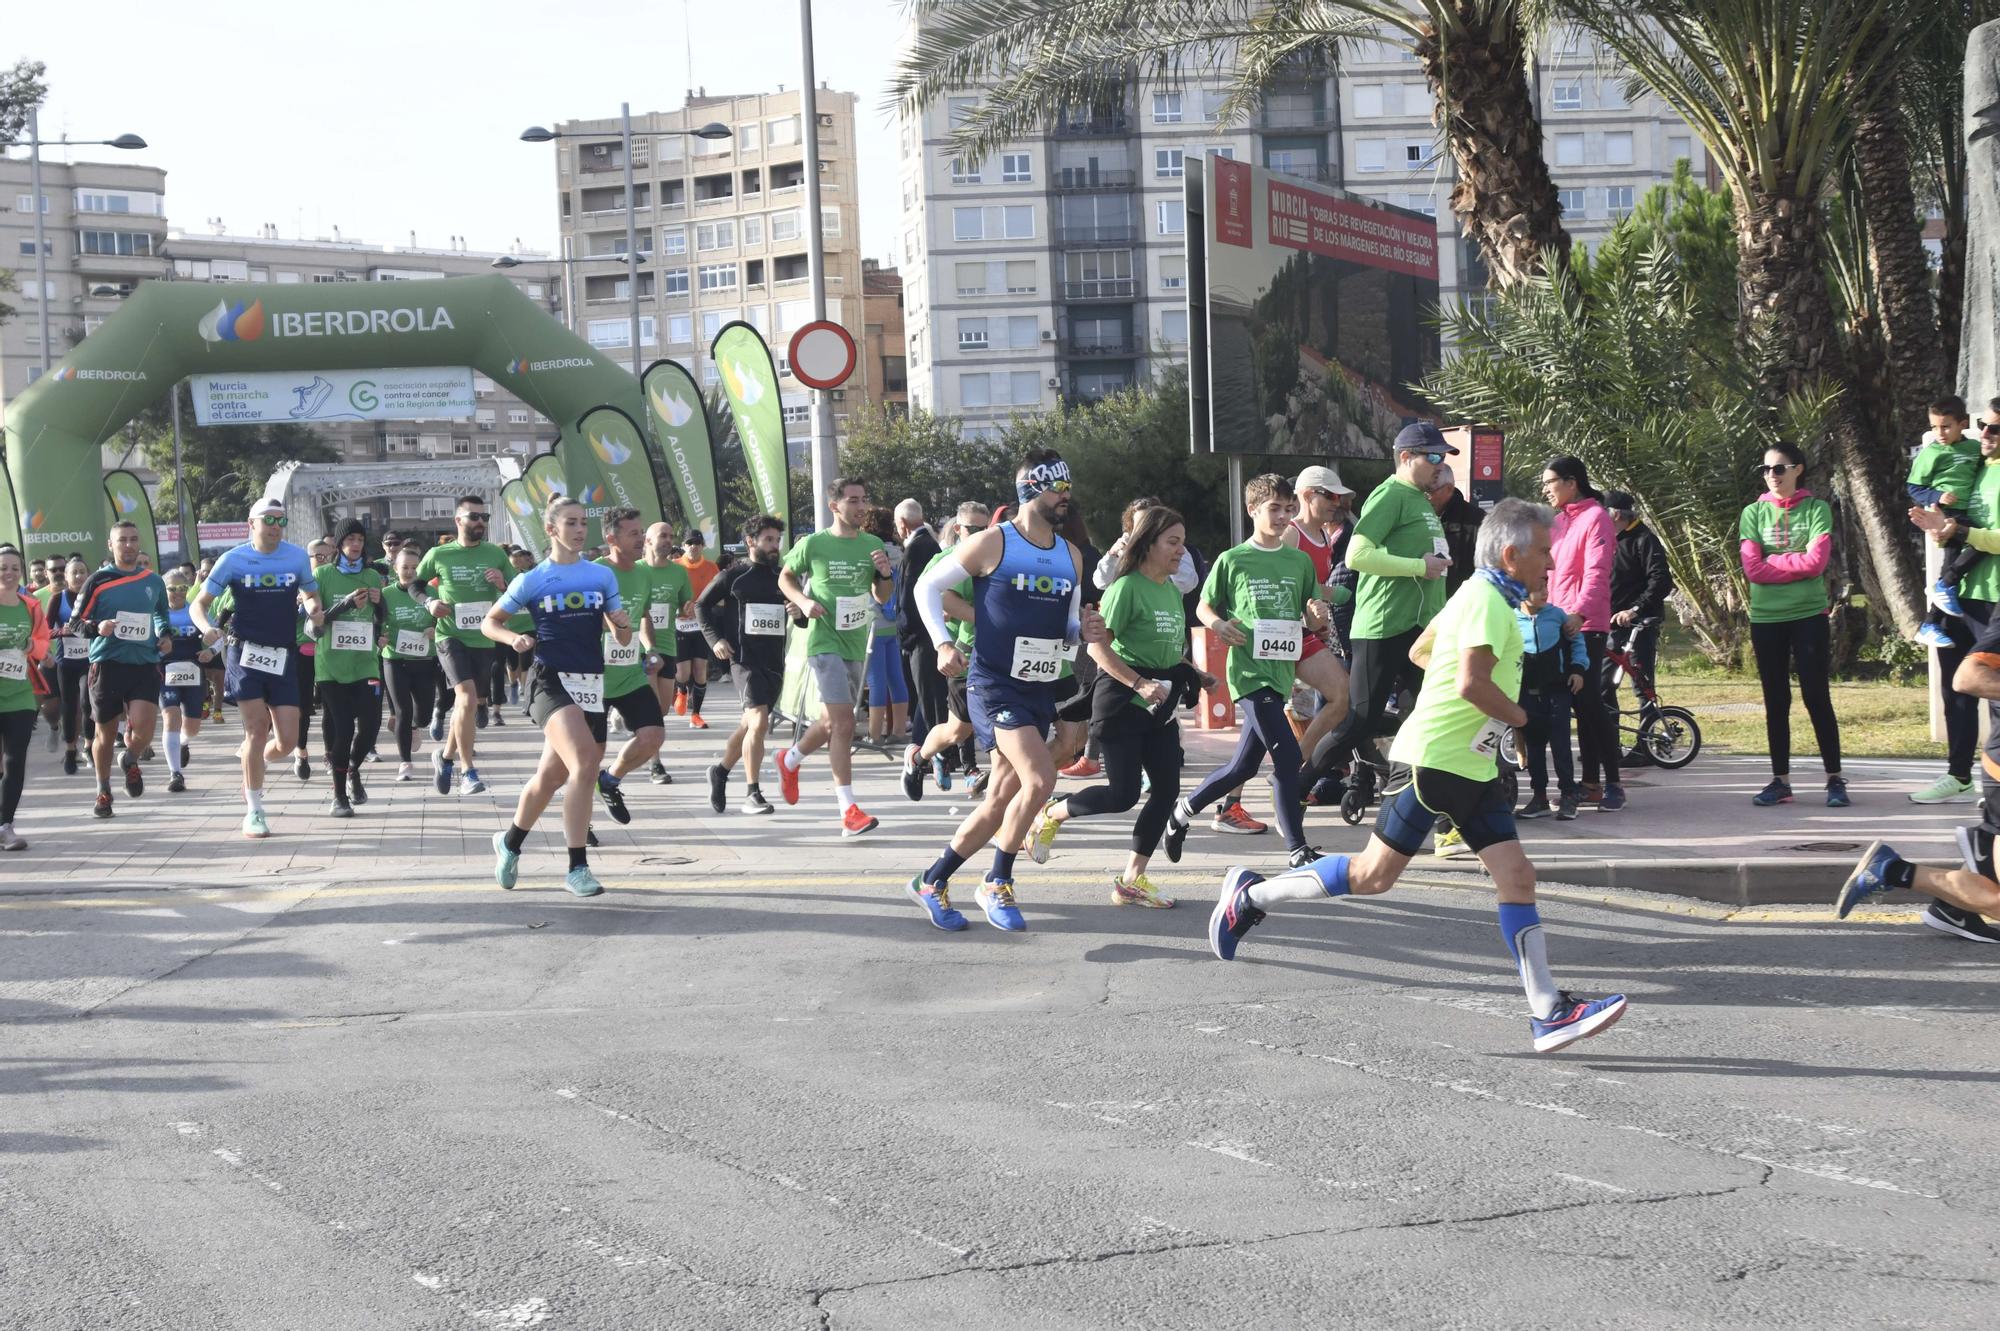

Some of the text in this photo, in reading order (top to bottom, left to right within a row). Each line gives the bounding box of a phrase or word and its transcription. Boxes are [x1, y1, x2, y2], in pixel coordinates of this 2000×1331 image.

[1271, 190, 1308, 218] MURCIA
[1272, 215, 1288, 239] RIO
[1339, 213, 1349, 228] DE
[1350, 216, 1400, 242] REVEGETACIÓN
[1400, 230, 1406, 242] Y
[1407, 231, 1433, 250] MEJORA
[1313, 226, 1324, 241] DE
[1324, 229, 1339, 246] LOS
[1340, 232, 1379, 255] MÁRGENES
[1379, 243, 1393, 258] DEL
[1393, 244, 1405, 262] RÍO
[272, 306, 455, 337] IBERDROLA
[530, 358, 594, 371] IBERDROLA
[76, 369, 147, 381] IBERDROLA
[209, 381, 247, 391] Murcia
[210, 390, 269, 400] en marcha
[384, 391, 411, 399] contra
[413, 391, 420, 399] el
[211, 401, 247, 410] contra
[384, 401, 396, 409] en
[436, 399, 447, 407] de
[449, 399, 476, 407] Murcia
[212, 410, 222, 419] el
[24, 531, 93, 544] IBERDROLA
[240, 572, 296, 588] HOPP
[1011, 573, 1072, 596] HOPP
[539, 591, 603, 613] HOPP
[461, 615, 486, 625] 009
[844, 610, 866, 624] 1225
[752, 619, 780, 629] 0868
[120, 625, 146, 636] 0710
[337, 635, 367, 645] 0263
[1261, 639, 1296, 653] 0440
[67, 647, 88, 655] 2404
[400, 641, 425, 652] 2416
[248, 653, 278, 668] 2421
[1021, 659, 1057, 677] 2405
[171, 673, 195, 681] 2204
